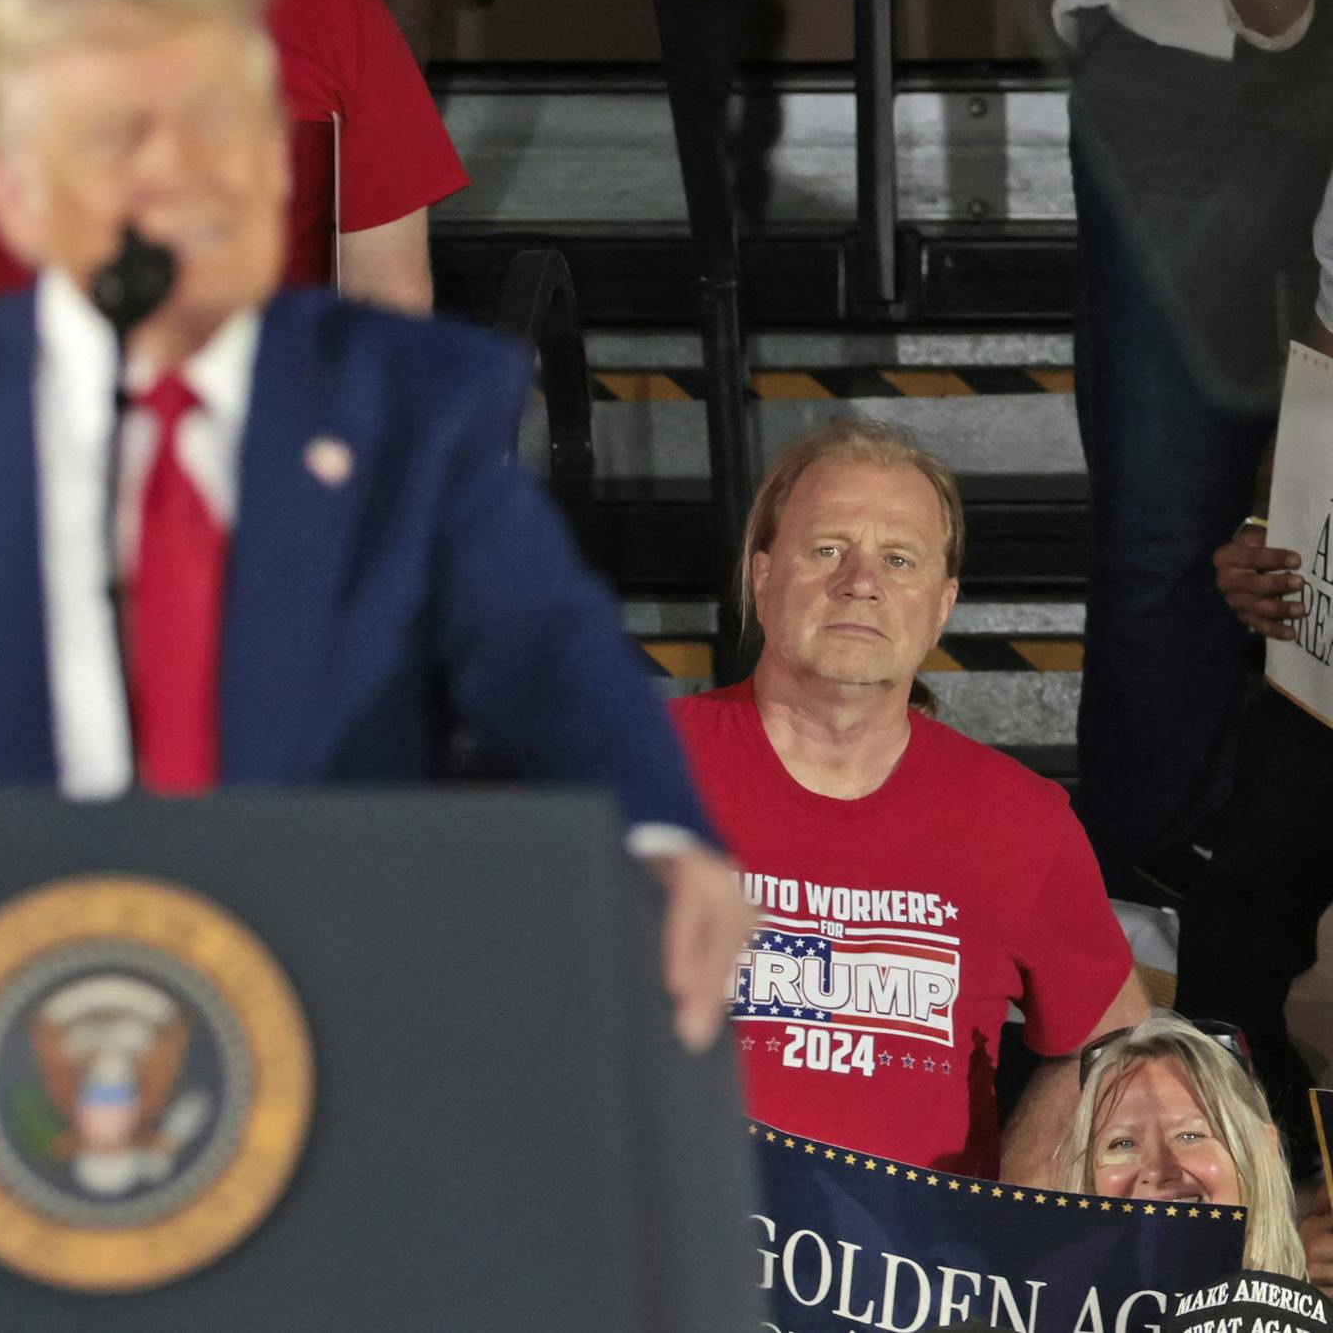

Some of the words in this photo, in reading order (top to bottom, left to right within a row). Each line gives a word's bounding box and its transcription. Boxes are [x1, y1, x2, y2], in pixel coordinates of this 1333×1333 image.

[804, 880, 944, 927] WORKERS
[820, 920, 844, 939] FOR
[782, 1025, 875, 1077] 2024
[1175, 1281, 1229, 1317] MAKE
[1232, 1279, 1328, 1325] AMERICA
